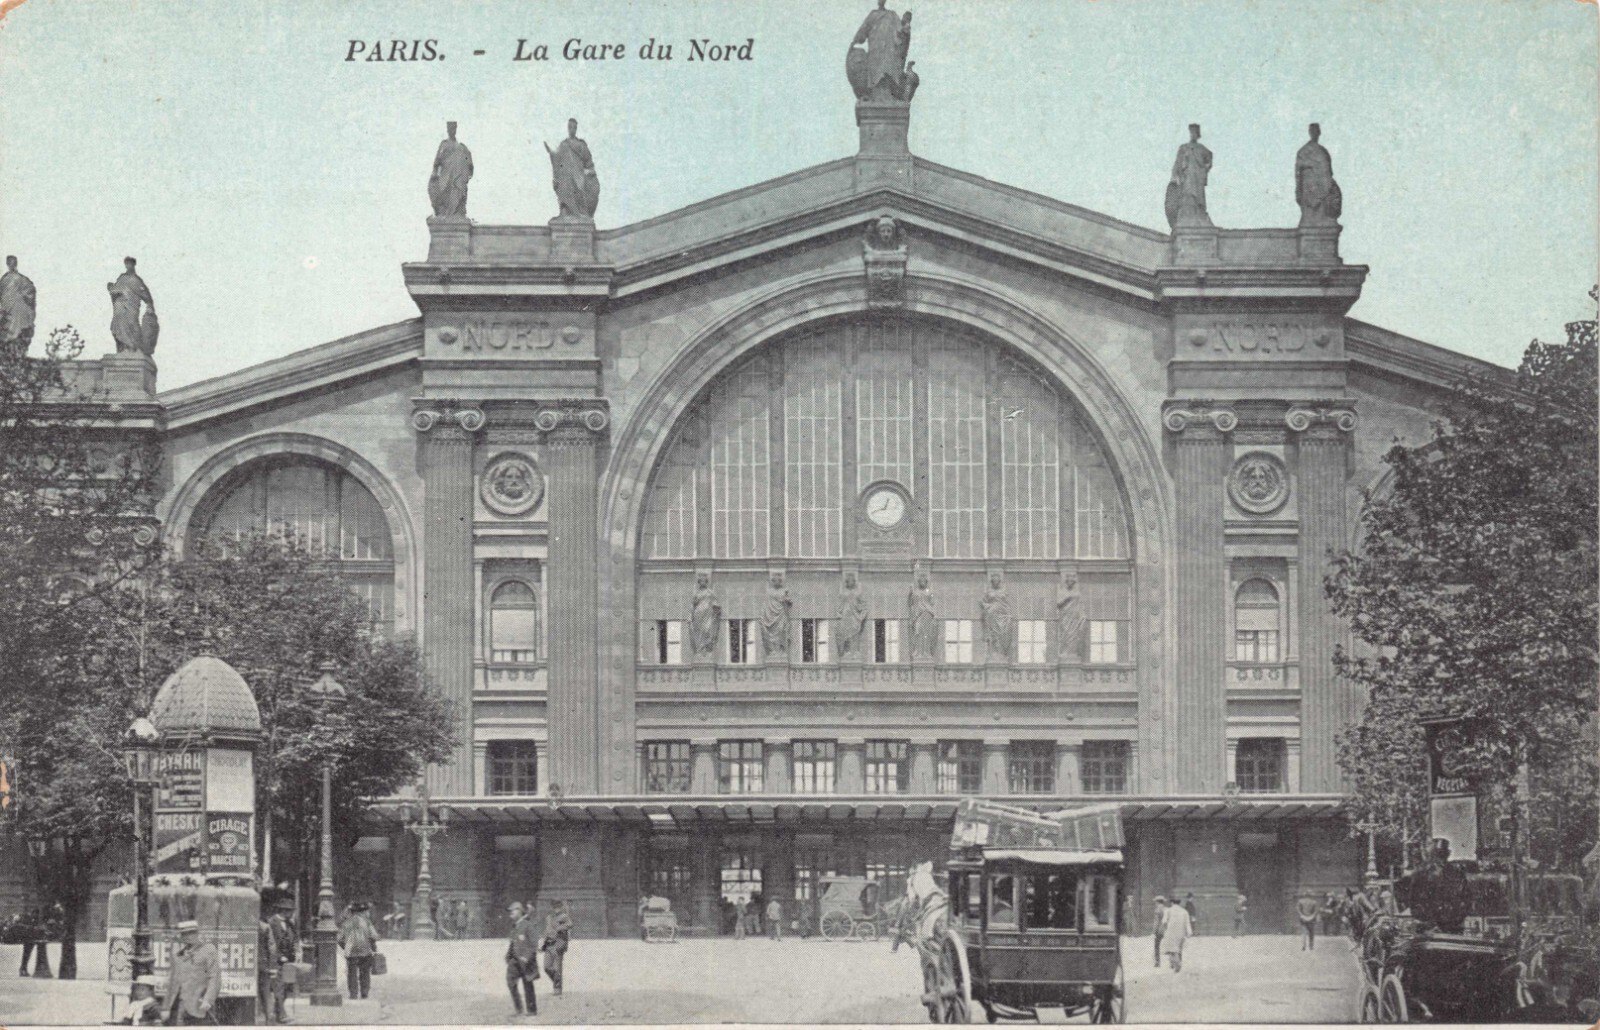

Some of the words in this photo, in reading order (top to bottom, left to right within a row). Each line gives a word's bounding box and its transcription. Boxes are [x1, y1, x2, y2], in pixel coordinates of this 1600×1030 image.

[463, 321, 555, 351] NORD
[1212, 322, 1306, 353] NORD
[208, 818, 249, 836] CIRAGE
